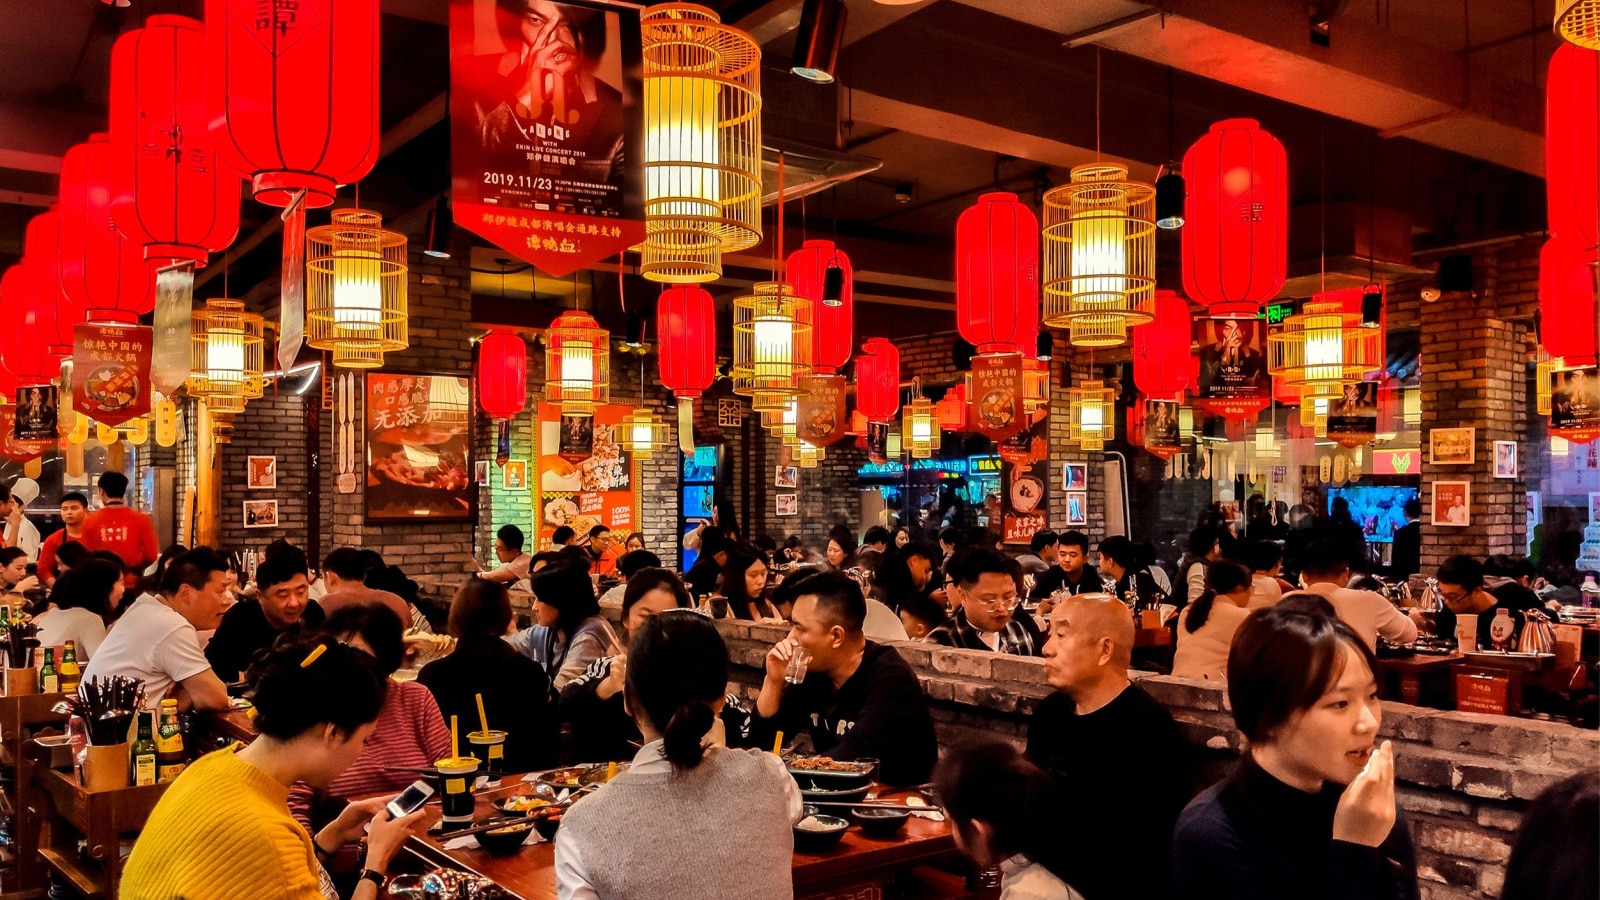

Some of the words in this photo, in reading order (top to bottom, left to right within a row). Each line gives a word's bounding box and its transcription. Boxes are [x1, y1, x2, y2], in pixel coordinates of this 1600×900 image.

[529, 123, 570, 141] ALONG
[515, 143, 531, 151] EKIN
[545, 147, 572, 156] CONCERT
[573, 150, 586, 158] 2019
[542, 140, 558, 148] WITH
[526, 153, 576, 166] 郑伊健演唱会
[483, 172, 552, 191] 2019.11/23
[482, 213, 622, 238] 郑伊健成都演唱会通路支持
[83, 339, 143, 352] 惊艳中国的
[90, 351, 137, 363] 成都火锅
[373, 377, 427, 394] 肉感厚足
[373, 406, 443, 431] 无添加
[612, 506, 630, 515] 100%
